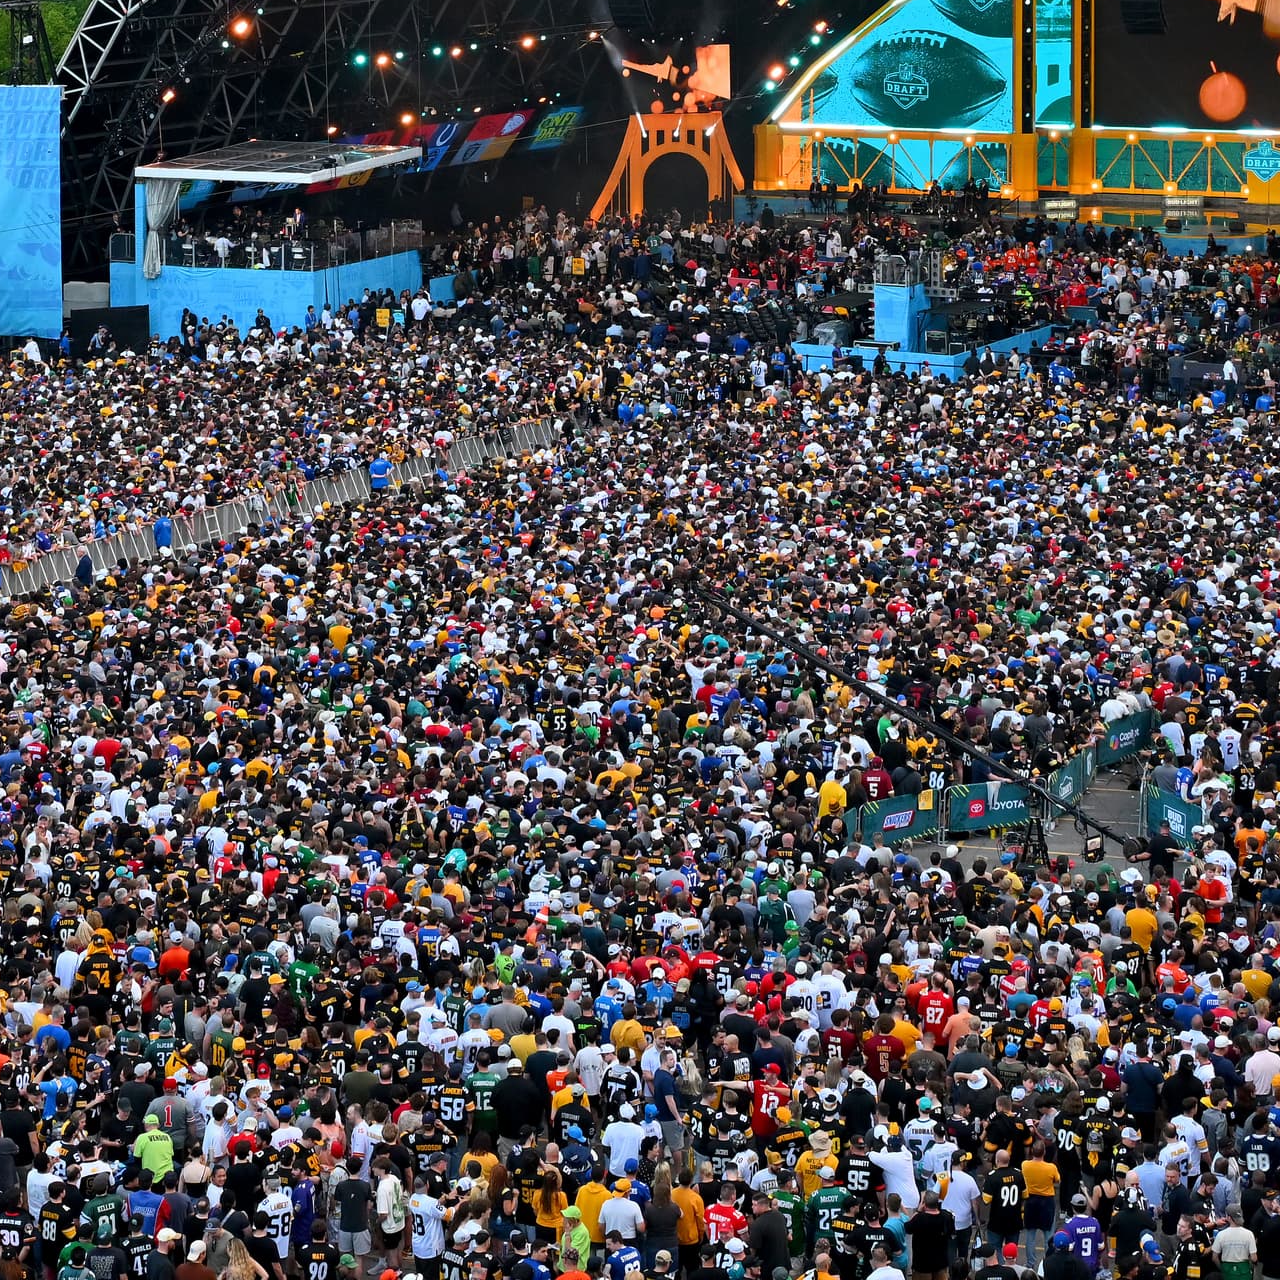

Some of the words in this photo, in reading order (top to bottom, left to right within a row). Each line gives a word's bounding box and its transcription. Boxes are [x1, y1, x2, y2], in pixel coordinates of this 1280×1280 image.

[887, 83, 924, 94] DRAFT
[1095, 685, 1110, 696] 54
[553, 716, 567, 730] 55
[1188, 712, 1196, 724] 8
[1226, 743, 1233, 756] 2
[928, 771, 945, 790] 86
[869, 782, 879, 796] 5
[991, 800, 1025, 811] OYOTA
[1167, 810, 1183, 823] BUD
[56, 881, 72, 897] 90
[1128, 957, 1138, 974] 97
[294, 978, 302, 994] 1
[326, 1006, 334, 1021] 9
[925, 1007, 944, 1025] 87
[828, 1044, 842, 1058] 21
[406, 1058, 415, 1073] 6
[879, 1053, 889, 1073] 5
[442, 1087, 463, 1096] LAMBERT
[440, 1097, 463, 1120] 58
[475, 1091, 492, 1111] 12
[164, 1104, 172, 1127] 1
[148, 1134, 170, 1142] VENDOR
[1057, 1130, 1074, 1150] 90
[1246, 1153, 1270, 1171] 88
[847, 1170, 868, 1190] 95
[1001, 1186, 1018, 1207] 90
[42, 1220, 57, 1241] 88
[267, 1211, 290, 1235] 58
[0, 1228, 20, 1247] 30
[1082, 1237, 1092, 1257] 9
[312, 1253, 327, 1261] WATT
[309, 1261, 328, 1280] 90
